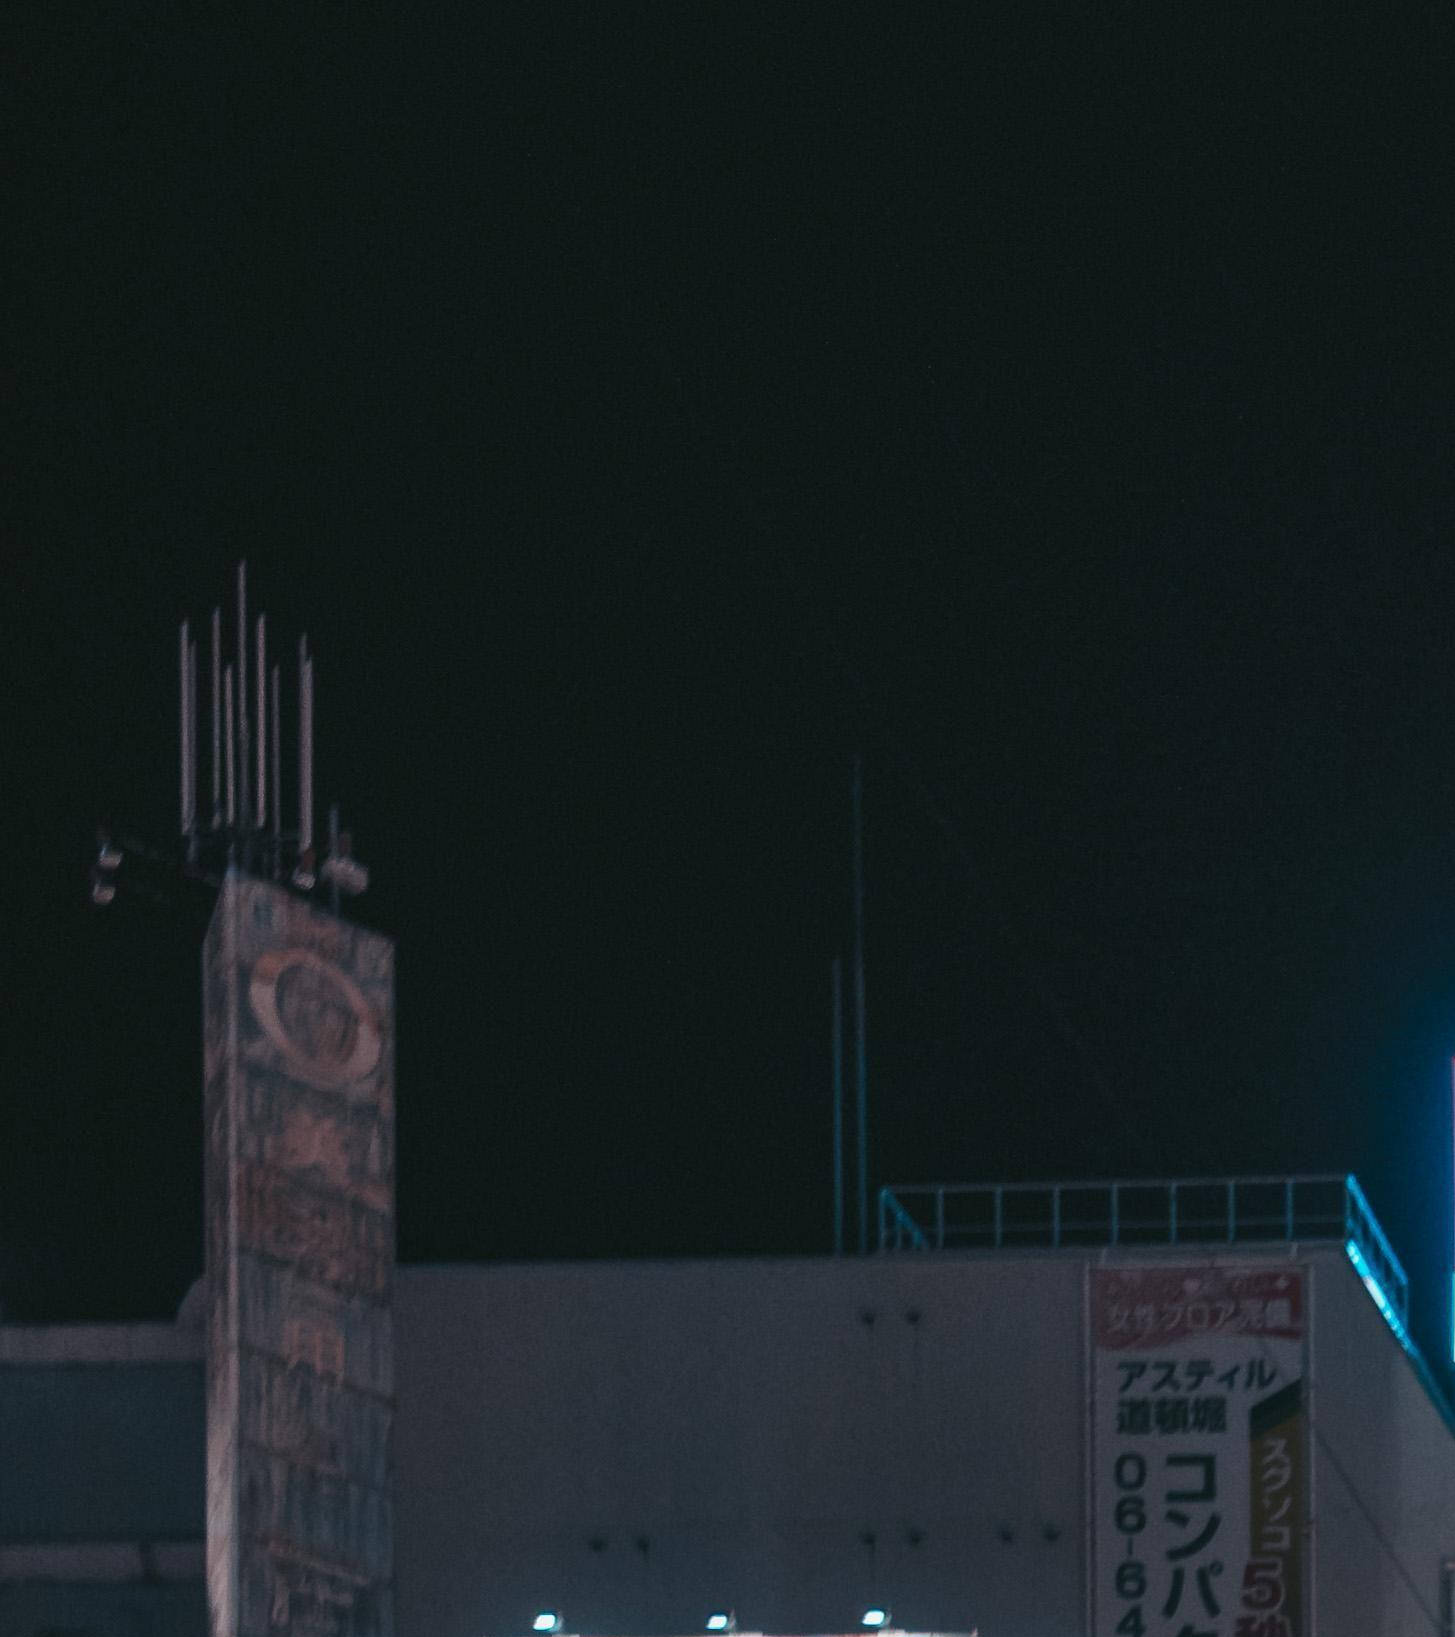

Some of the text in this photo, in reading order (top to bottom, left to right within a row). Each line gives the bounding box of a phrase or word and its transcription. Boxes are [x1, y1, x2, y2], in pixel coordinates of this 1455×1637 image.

[1115, 1360, 1275, 1394] アスティル
